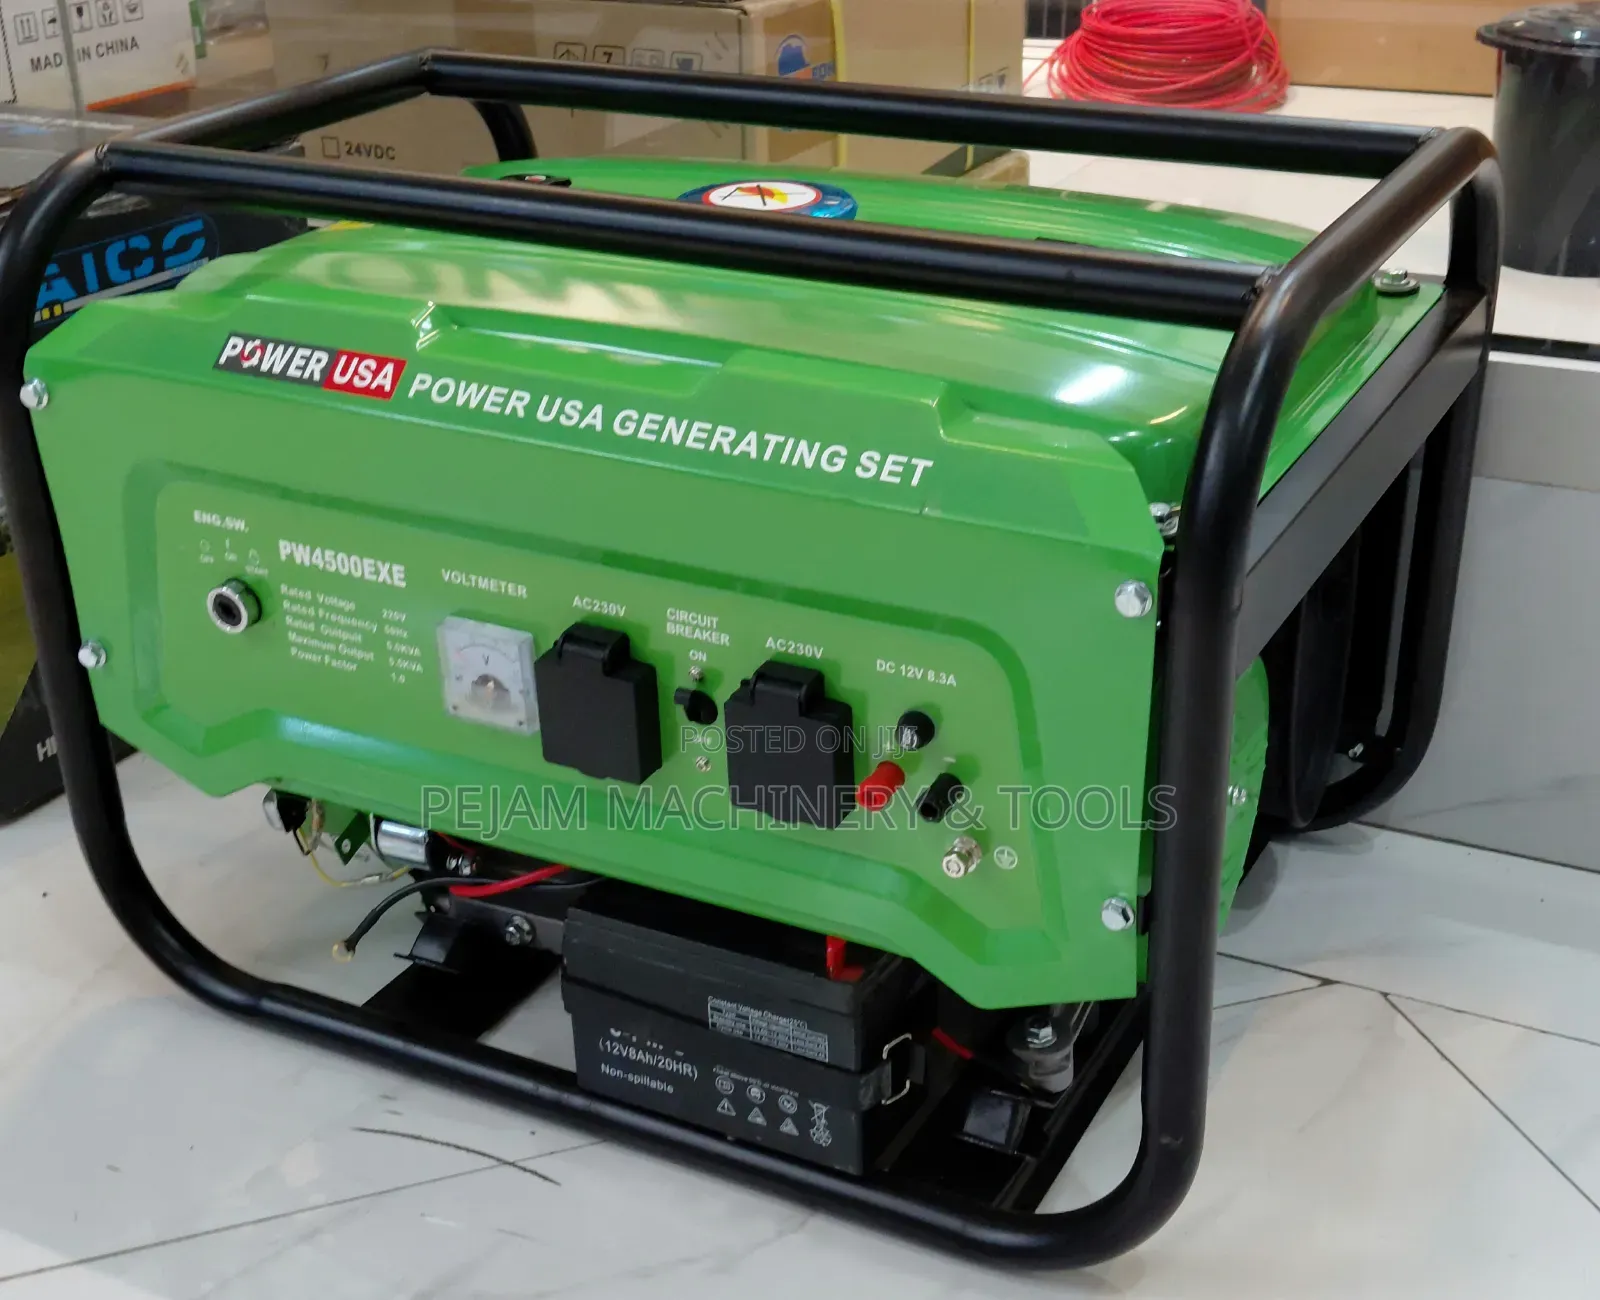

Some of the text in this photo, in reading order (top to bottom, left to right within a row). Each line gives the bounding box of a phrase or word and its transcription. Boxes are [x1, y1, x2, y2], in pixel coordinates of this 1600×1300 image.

[30, 36, 140, 73] MAD IN CHINA
[344, 141, 396, 161] 24VDC
[218, 336, 395, 393] POWER USA
[408, 373, 934, 487] POWER USA GENERATING SET
[279, 539, 406, 588] PW4500EXE
[281, 583, 312, 601] Rated
[441, 568, 528, 599] VOLTMETER
[572, 595, 627, 617] AC230V
[666, 607, 718, 629] CIRCUIT
[666, 621, 730, 646] BREAKER
[765, 636, 823, 659] AC230V
[689, 649, 707, 662] ON
[876, 659, 957, 687] DC 12V 8.3A
[598, 1036, 698, 1082] (12V8Ah/20HR)
[600, 1062, 675, 1094] Non-spillable
